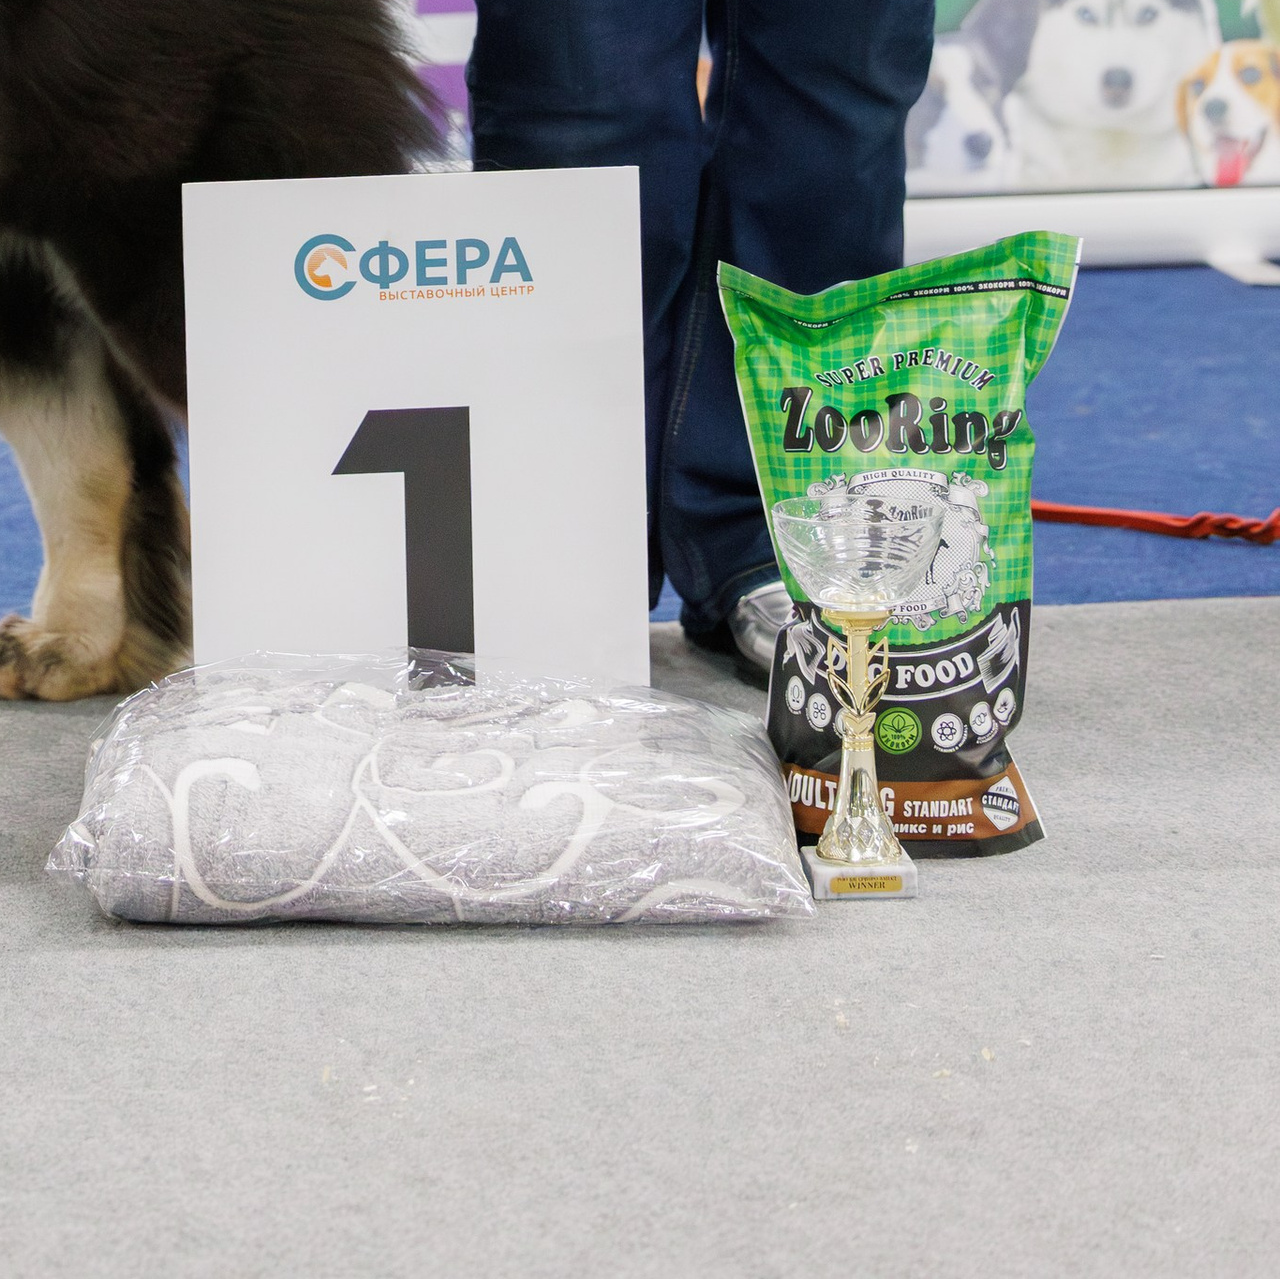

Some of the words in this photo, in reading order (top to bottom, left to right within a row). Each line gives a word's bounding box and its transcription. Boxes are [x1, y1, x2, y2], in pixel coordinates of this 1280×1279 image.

[293, 232, 535, 302] СФЕРА
[378, 285, 487, 302] ВЫСТАВОЧНЫЙ
[490, 284, 536, 299] ЦЕНТР
[953, 284, 975, 293] 100%
[978, 280, 1015, 291] ЭКОКОРМ
[814, 354, 886, 389] SUPER
[893, 346, 997, 392] PREMIUM
[780, 386, 1023, 471] ZooRing
[862, 471, 888, 482] HIGH
[891, 469, 937, 481] QUALITY
[331, 405, 477, 687] 1
[900, 602, 928, 613] FOOD
[895, 651, 975, 690] FOOD
[903, 796, 974, 818] STANDART
[947, 822, 975, 837] рис
[849, 881, 886, 889] WINNER
